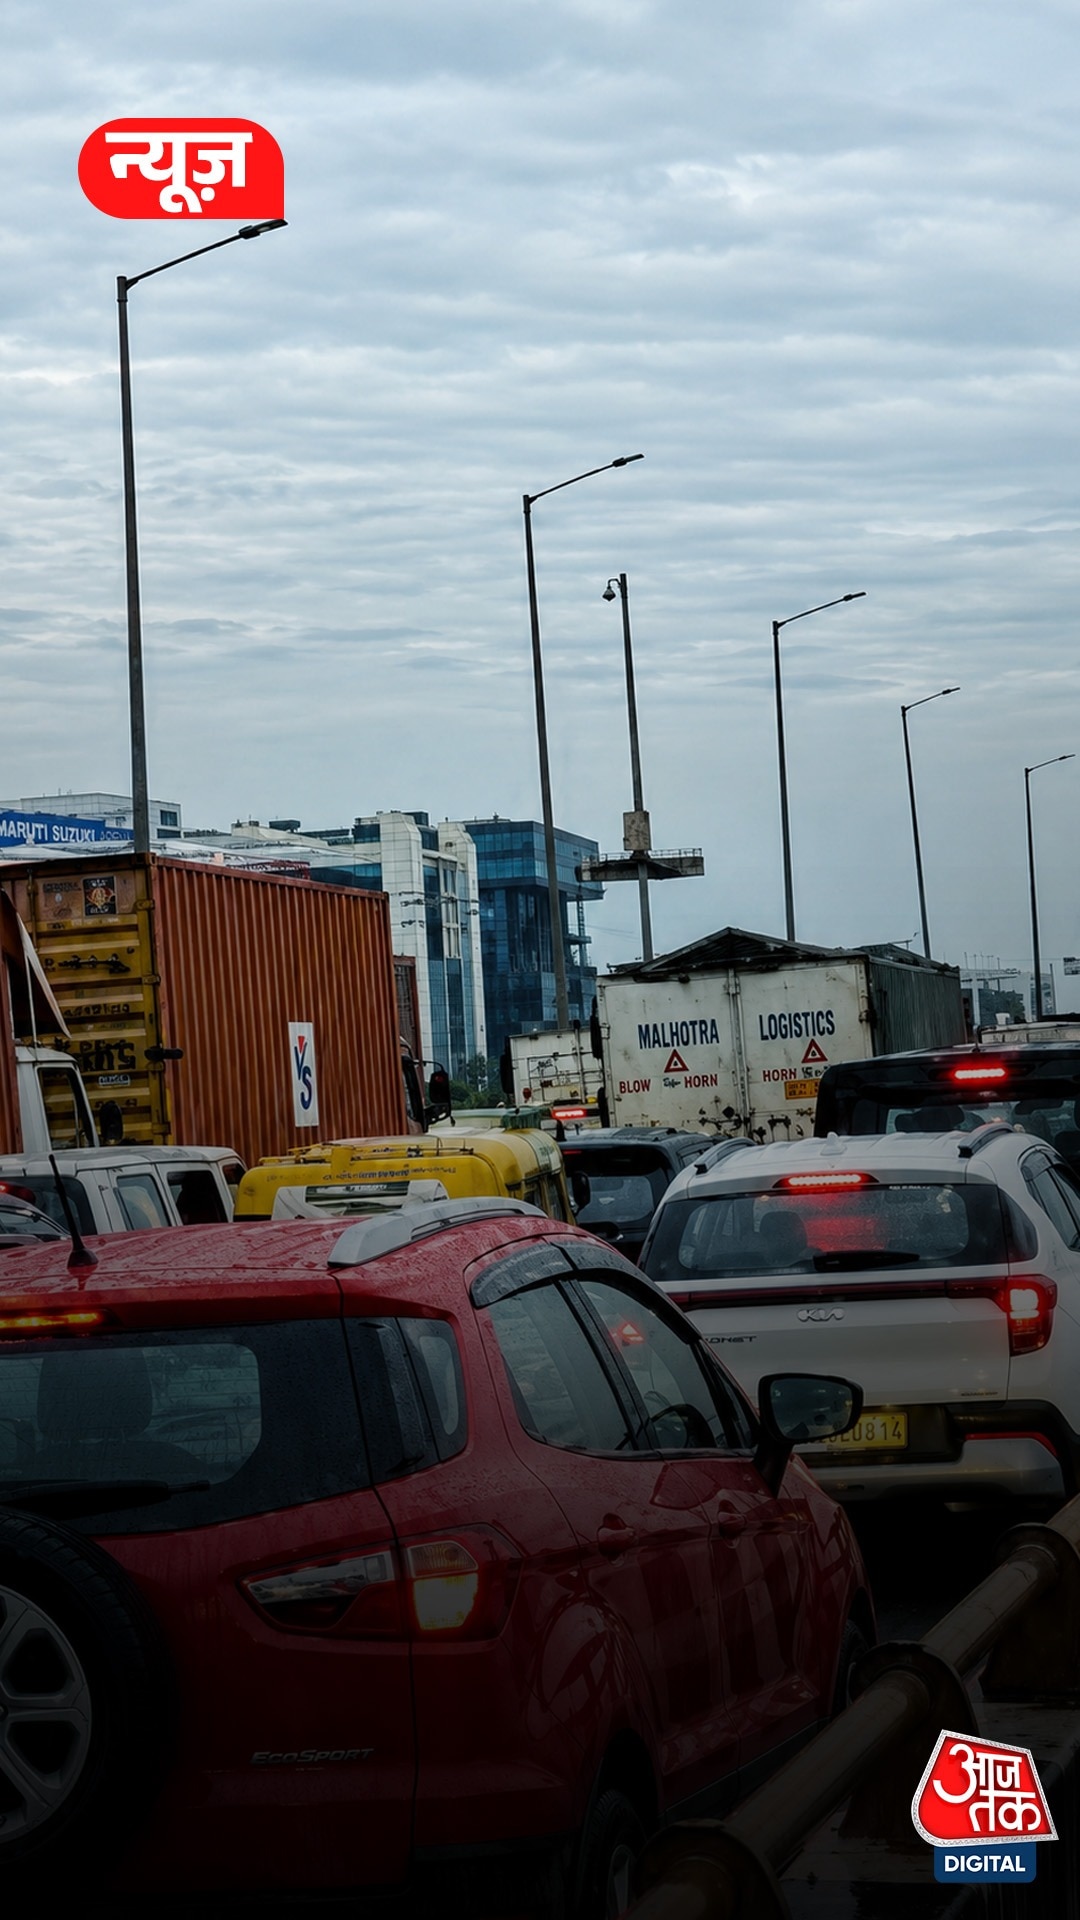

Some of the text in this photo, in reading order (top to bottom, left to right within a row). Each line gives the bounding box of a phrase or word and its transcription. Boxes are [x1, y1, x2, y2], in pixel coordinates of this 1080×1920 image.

[52, 825, 95, 843] SUZUKI
[638, 1010, 835, 1049] MALHOTRA LOGISTICS
[763, 1068, 797, 1082] HORN
[619, 1079, 651, 1094] BLOW
[684, 1074, 718, 1088] HORN
[797, 1308, 844, 1322] KIA
[704, 1335, 757, 1344] ONET
